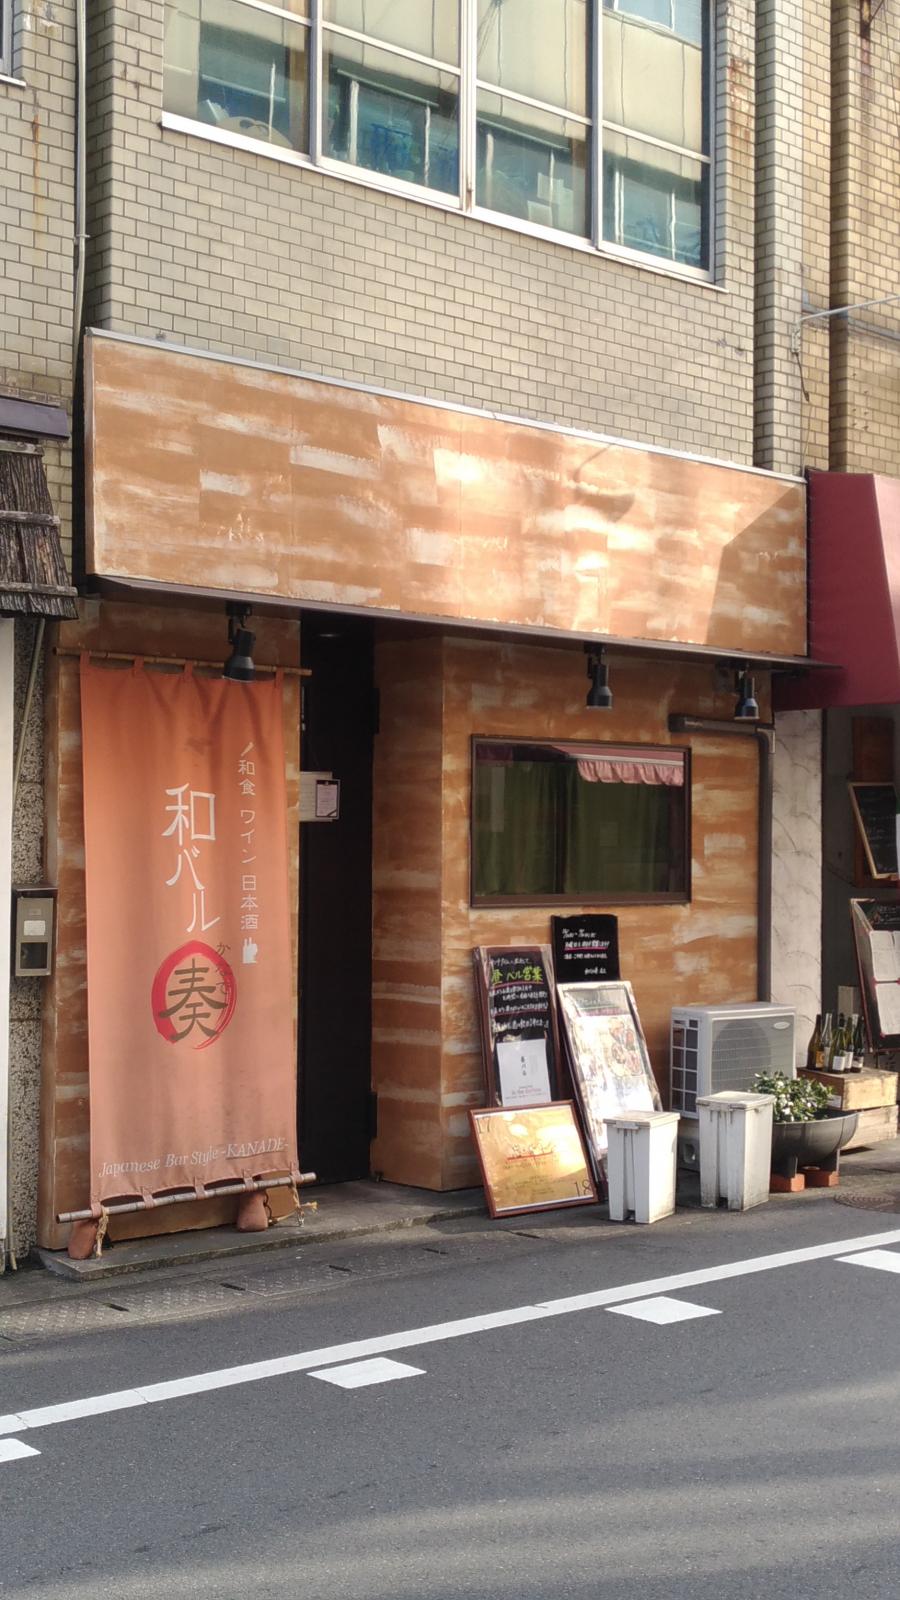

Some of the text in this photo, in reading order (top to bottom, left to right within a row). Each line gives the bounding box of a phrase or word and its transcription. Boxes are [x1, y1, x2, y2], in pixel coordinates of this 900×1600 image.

[161, 781, 221, 933] 和バル
[238, 759, 259, 931] 和食 ワイン 日本酒
[159, 957, 228, 1042] 奏
[98, 1158, 161, 1178] Japanese
[164, 1153, 189, 1168] Bar
[190, 1145, 219, 1167] Style
